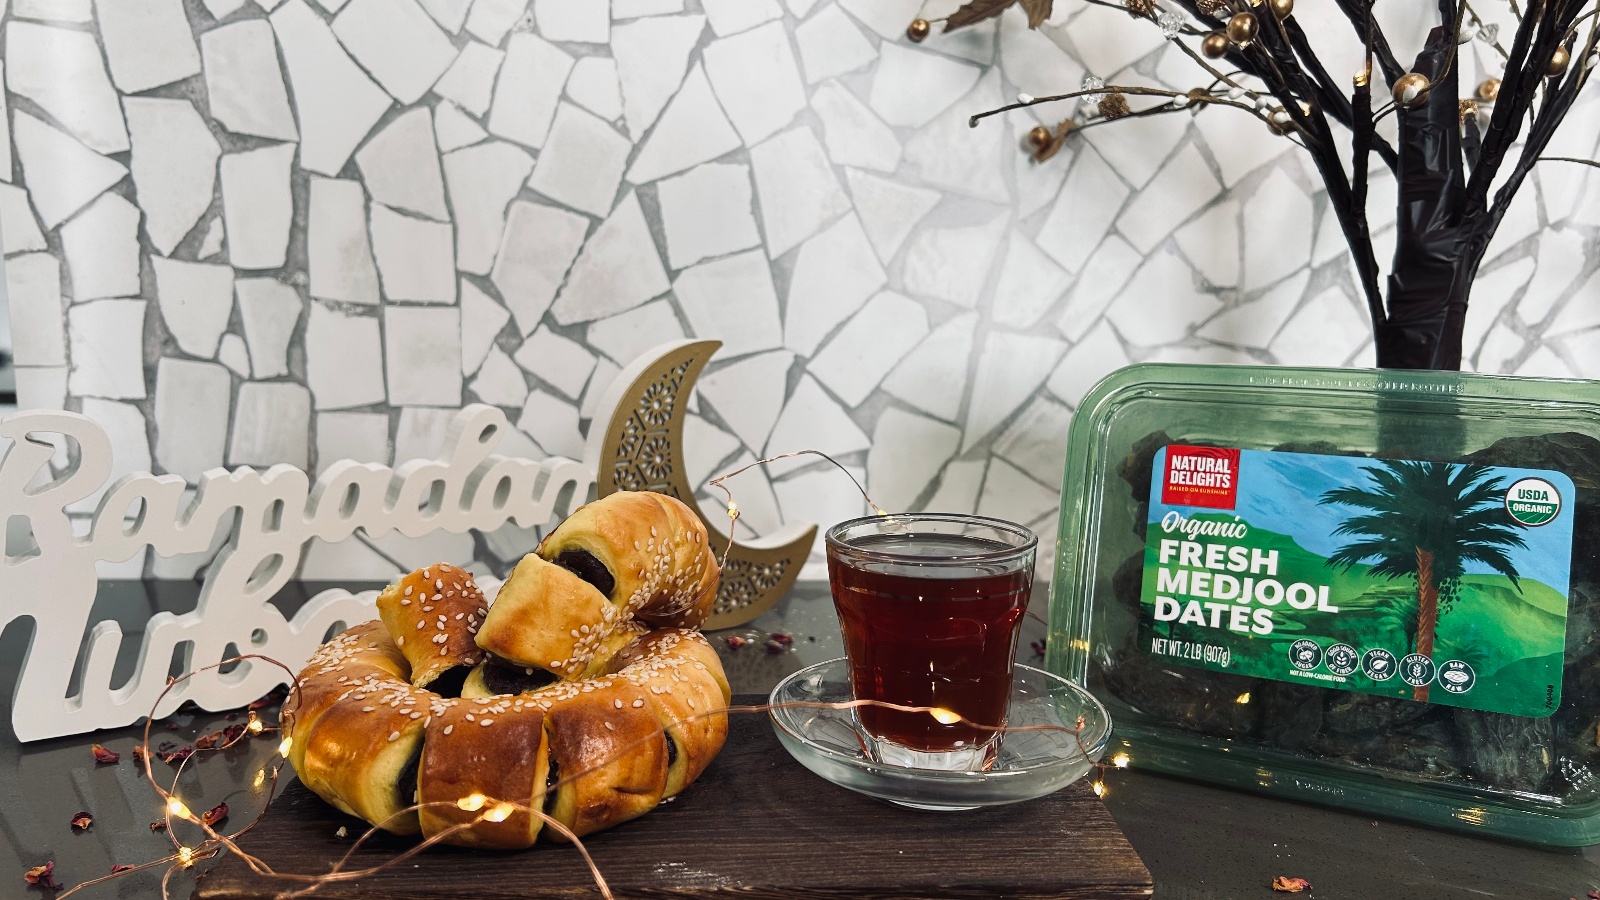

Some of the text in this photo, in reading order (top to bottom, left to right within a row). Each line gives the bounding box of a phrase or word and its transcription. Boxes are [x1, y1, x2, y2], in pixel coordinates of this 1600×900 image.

[1171, 455, 1231, 473] NATURAL
[0, 403, 597, 563] Ramadan
[1169, 470, 1231, 488] DELIGHTS
[1517, 489, 1549, 501] USDA
[1512, 502, 1553, 514] ORGANIC
[1161, 511, 1248, 541] Organic
[1159, 538, 1279, 576] FRESH
[1156, 567, 1339, 614] MEDJOOL
[1154, 595, 1274, 635] DATES
[1151, 637, 1231, 668] NET WT. 2 LB (907g)
[1369, 650, 1390, 659] VEGAN
[1406, 655, 1430, 665] GLUTEN
[1366, 669, 1389, 680] VEGAN
[1407, 676, 1424, 685] FREE
[1445, 683, 1463, 692] RAW
